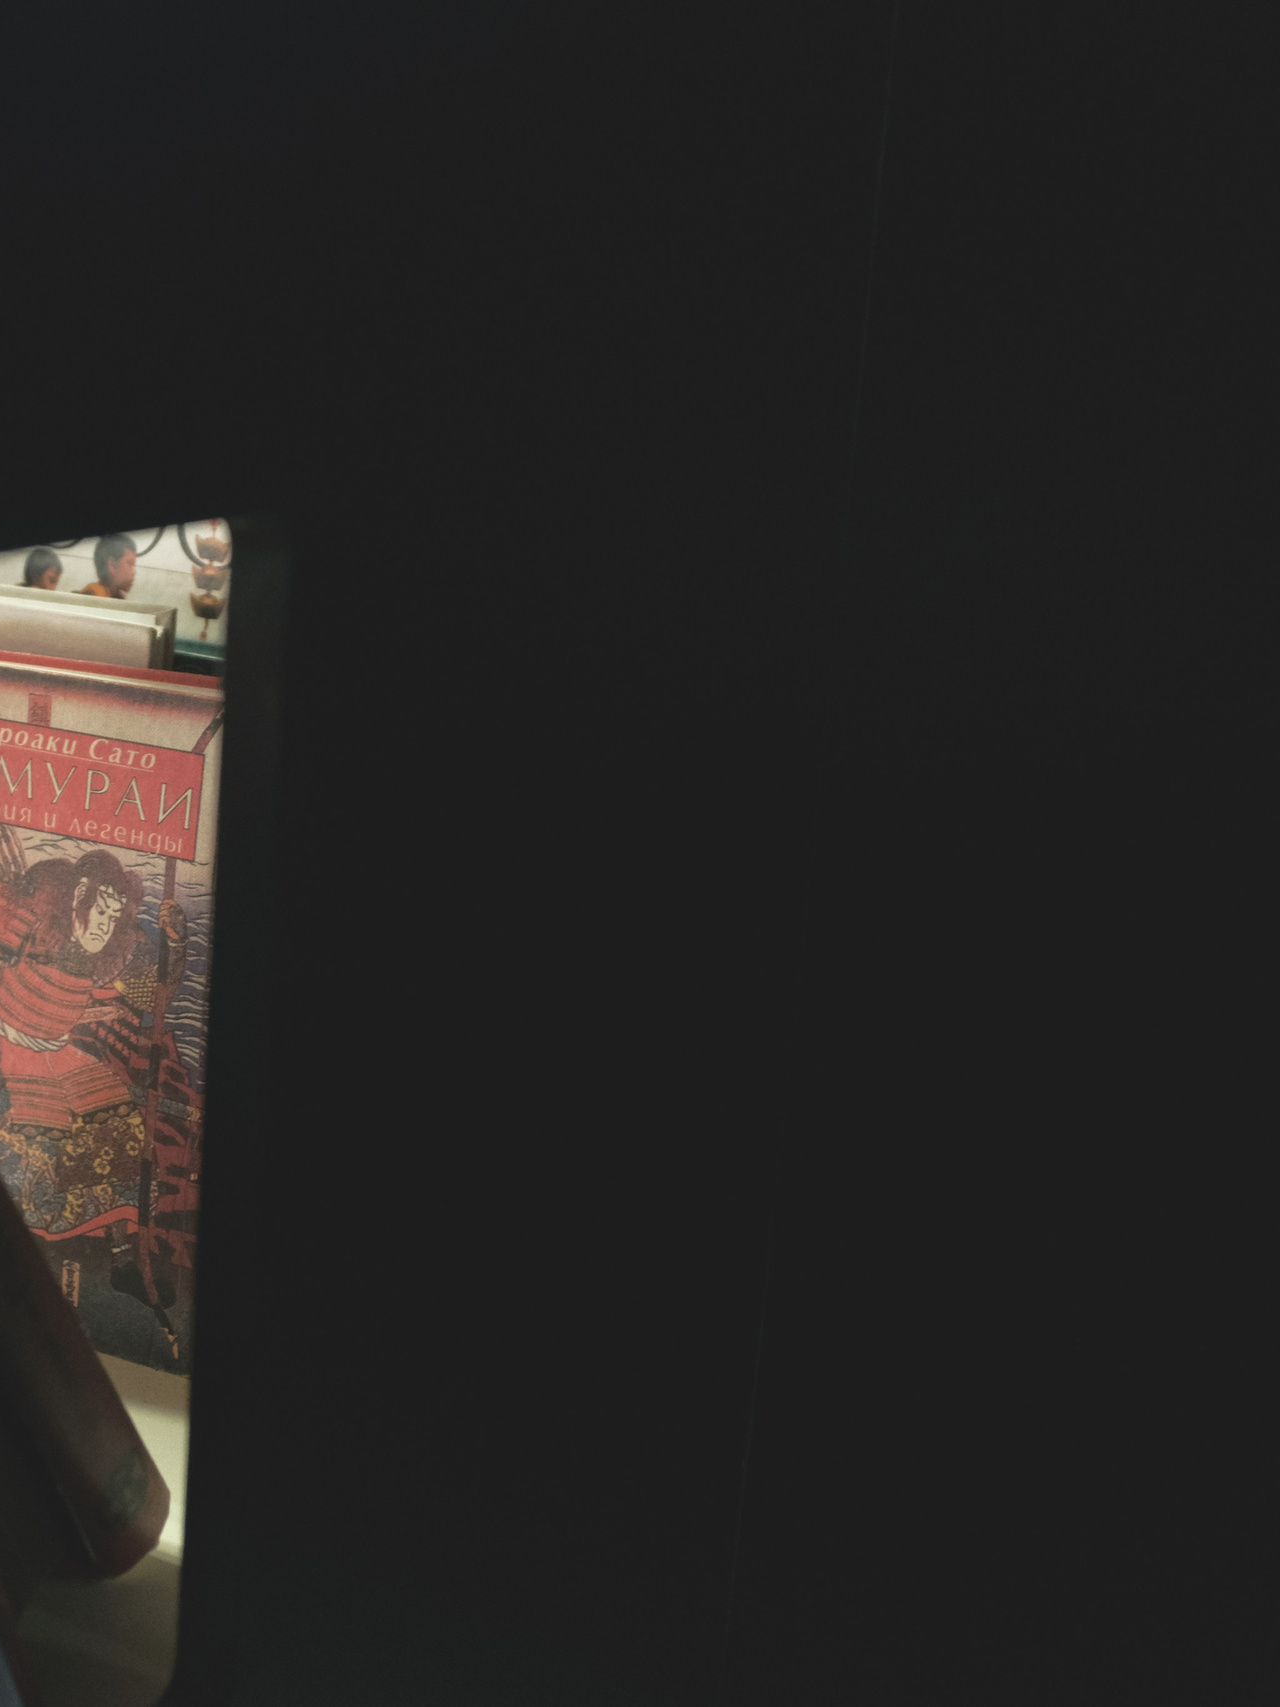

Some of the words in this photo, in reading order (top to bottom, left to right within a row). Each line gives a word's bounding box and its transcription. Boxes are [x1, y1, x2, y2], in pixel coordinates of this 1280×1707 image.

[89, 738, 157, 769] Сато
[43, 811, 57, 829] и
[69, 817, 183, 855] легенды
